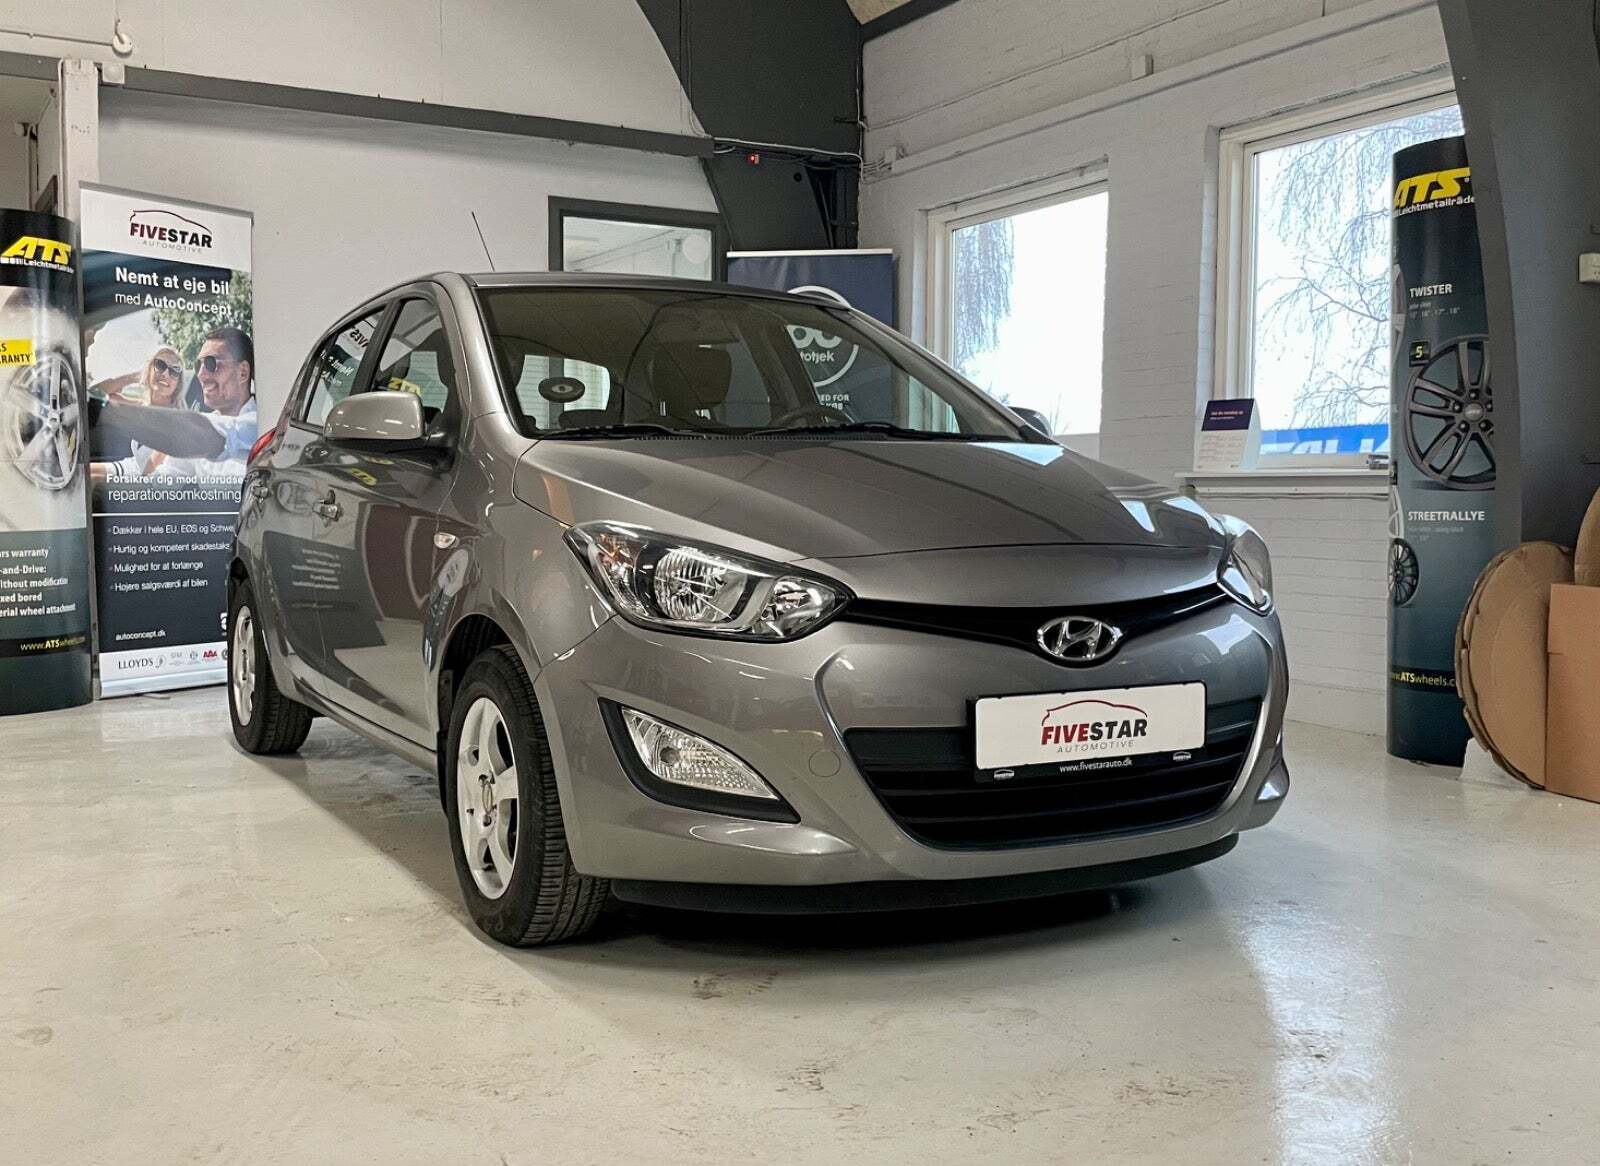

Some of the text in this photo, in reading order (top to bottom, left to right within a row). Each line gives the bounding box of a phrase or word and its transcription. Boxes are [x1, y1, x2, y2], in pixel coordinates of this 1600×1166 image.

[1393, 167, 1471, 208] ATS
[130, 222, 213, 248] FIVESTAR
[1, 236, 72, 265] ATS
[142, 240, 202, 254] AUTOMOTIVE
[115, 266, 229, 295] Nemt at eje bil
[1409, 283, 1453, 298] TWISTER
[115, 293, 232, 316] med AutoConcept
[1415, 345, 1424, 358] 5
[833, 394, 849, 402] FOR
[106, 473, 154, 485] Forsikrer
[156, 474, 174, 486] dig
[176, 474, 198, 484] mod
[108, 488, 242, 503] reparationsomkostning
[1407, 511, 1486, 521] STREETRALLYE
[165, 524, 179, 534] EU,
[199, 525, 209, 535] og
[11, 549, 49, 559] warranty
[113, 545, 137, 556] Hurtig
[138, 545, 149, 555] og
[150, 543, 190, 553] kompetent
[114, 562, 149, 574] Mulighed
[150, 561, 160, 571] for
[191, 579, 208, 588] bilen
[17, 591, 43, 602] bored
[19, 605, 46, 616] wheel
[115, 629, 167, 641] autoconcept.dk
[1041, 718, 1148, 745] FIVESTAR
[1056, 740, 1135, 753] AUTOMOTIVE
[1060, 757, 1133, 773] www.fivestarauto.dk
